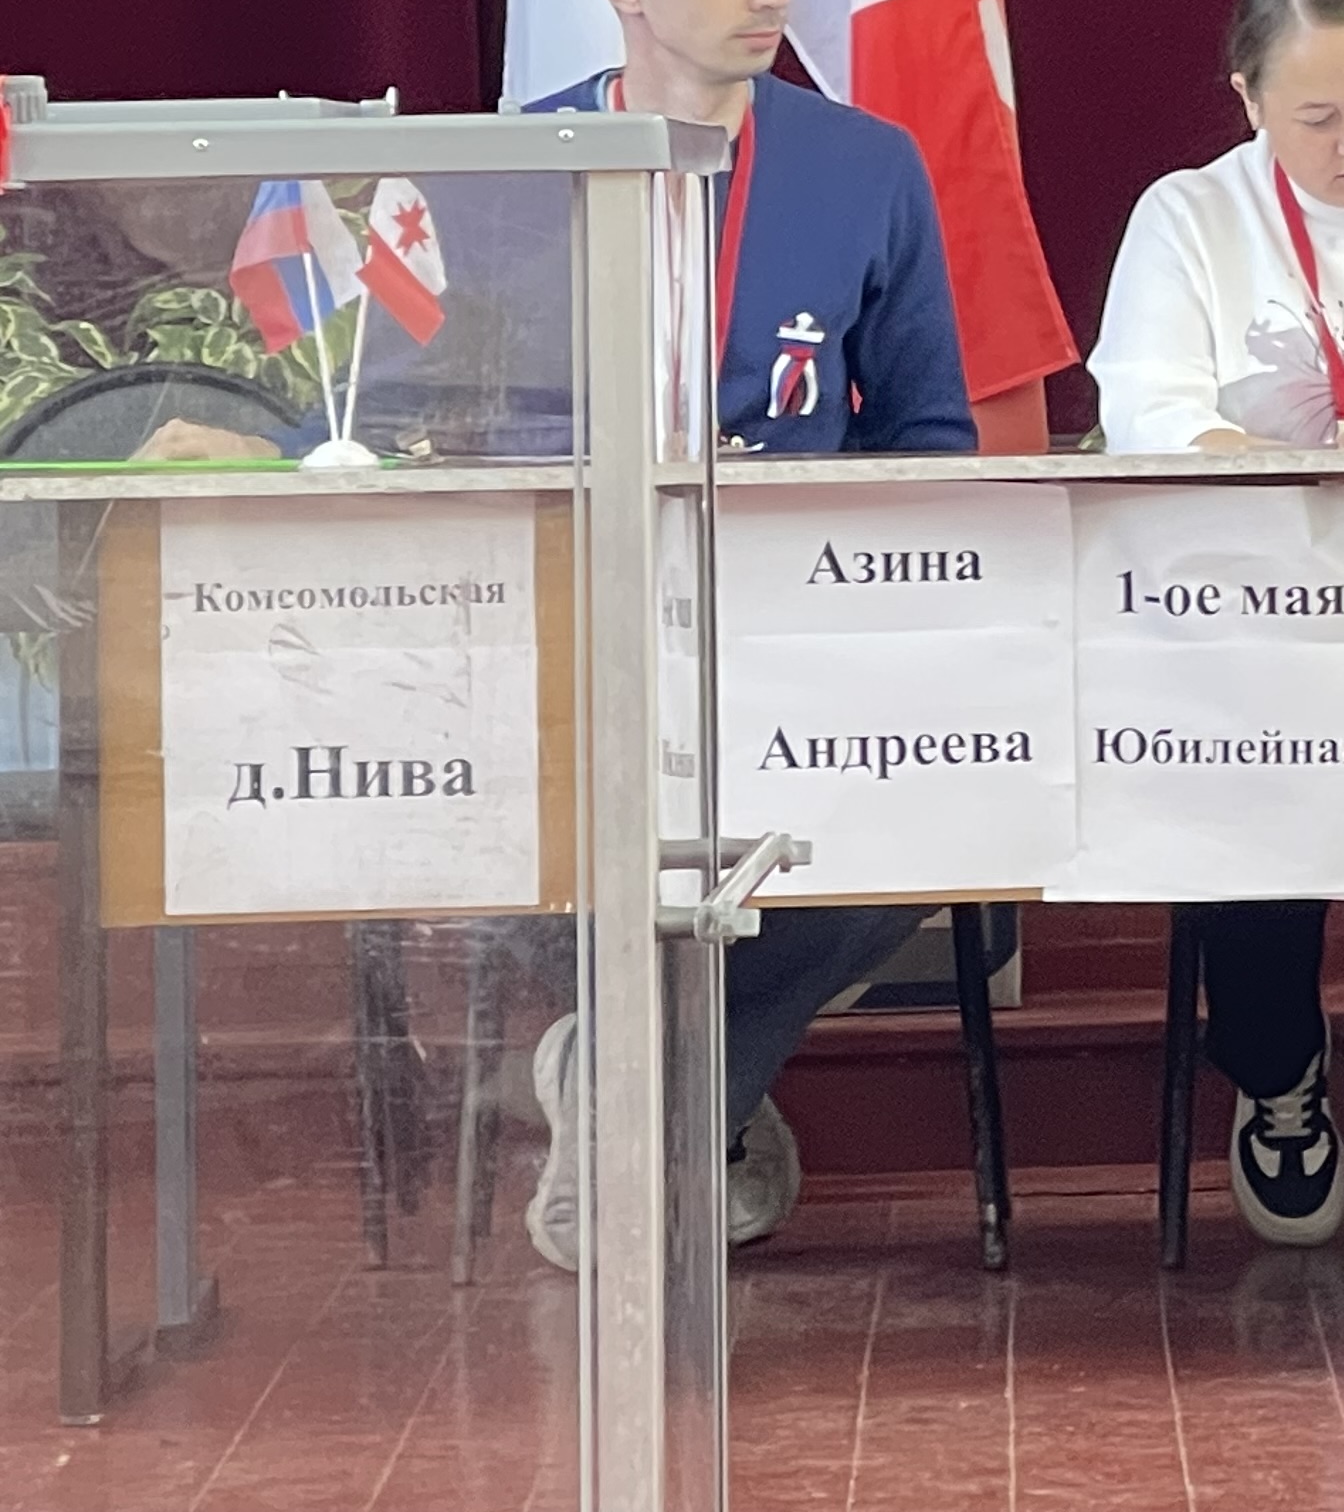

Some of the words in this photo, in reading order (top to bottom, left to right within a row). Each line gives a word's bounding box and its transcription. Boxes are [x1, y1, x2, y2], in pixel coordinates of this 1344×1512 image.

[806, 540, 983, 585] Азина
[193, 581, 506, 613] Комсомольская
[1116, 569, 1221, 617] 1-ое
[1241, 584, 1344, 616] мая
[228, 745, 477, 809] д.Нива
[758, 726, 1033, 780] Андреева
